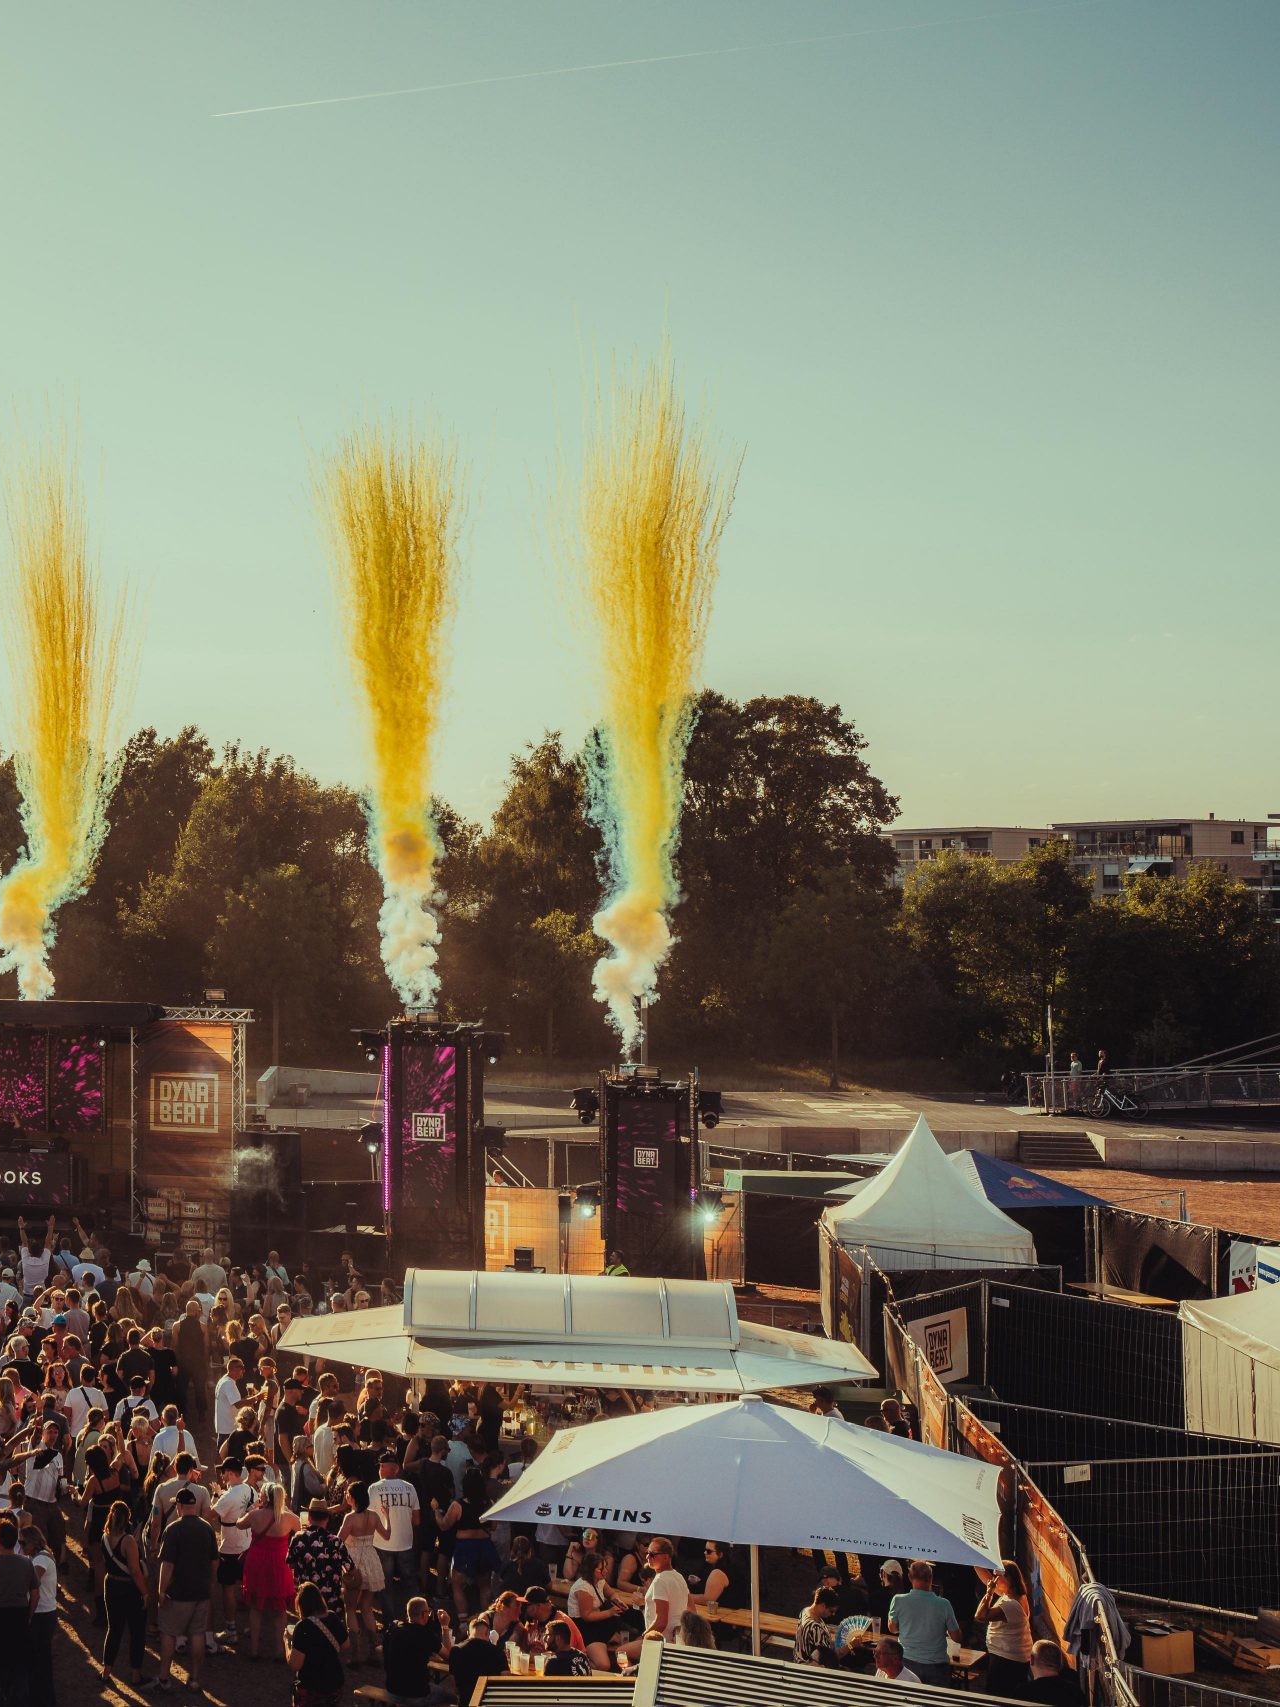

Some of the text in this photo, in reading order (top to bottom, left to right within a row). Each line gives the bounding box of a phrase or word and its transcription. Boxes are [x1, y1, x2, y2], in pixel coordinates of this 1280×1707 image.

[160, 1080, 209, 1102] DYNA
[160, 1101, 209, 1124] BEAT
[416, 1116, 441, 1127] DYNA
[416, 1126, 441, 1137] BEAT
[637, 1150, 655, 1158] DYNA
[637, 1157, 655, 1165] BEAT
[184, 1206, 201, 1214] EDM
[928, 1328, 948, 1350] DYNA
[929, 1347, 949, 1369] BEAT
[379, 1492, 413, 1508] HELL
[558, 1504, 652, 1524] VELTINS
[809, 1534, 885, 1548] BRAUTRADITION
